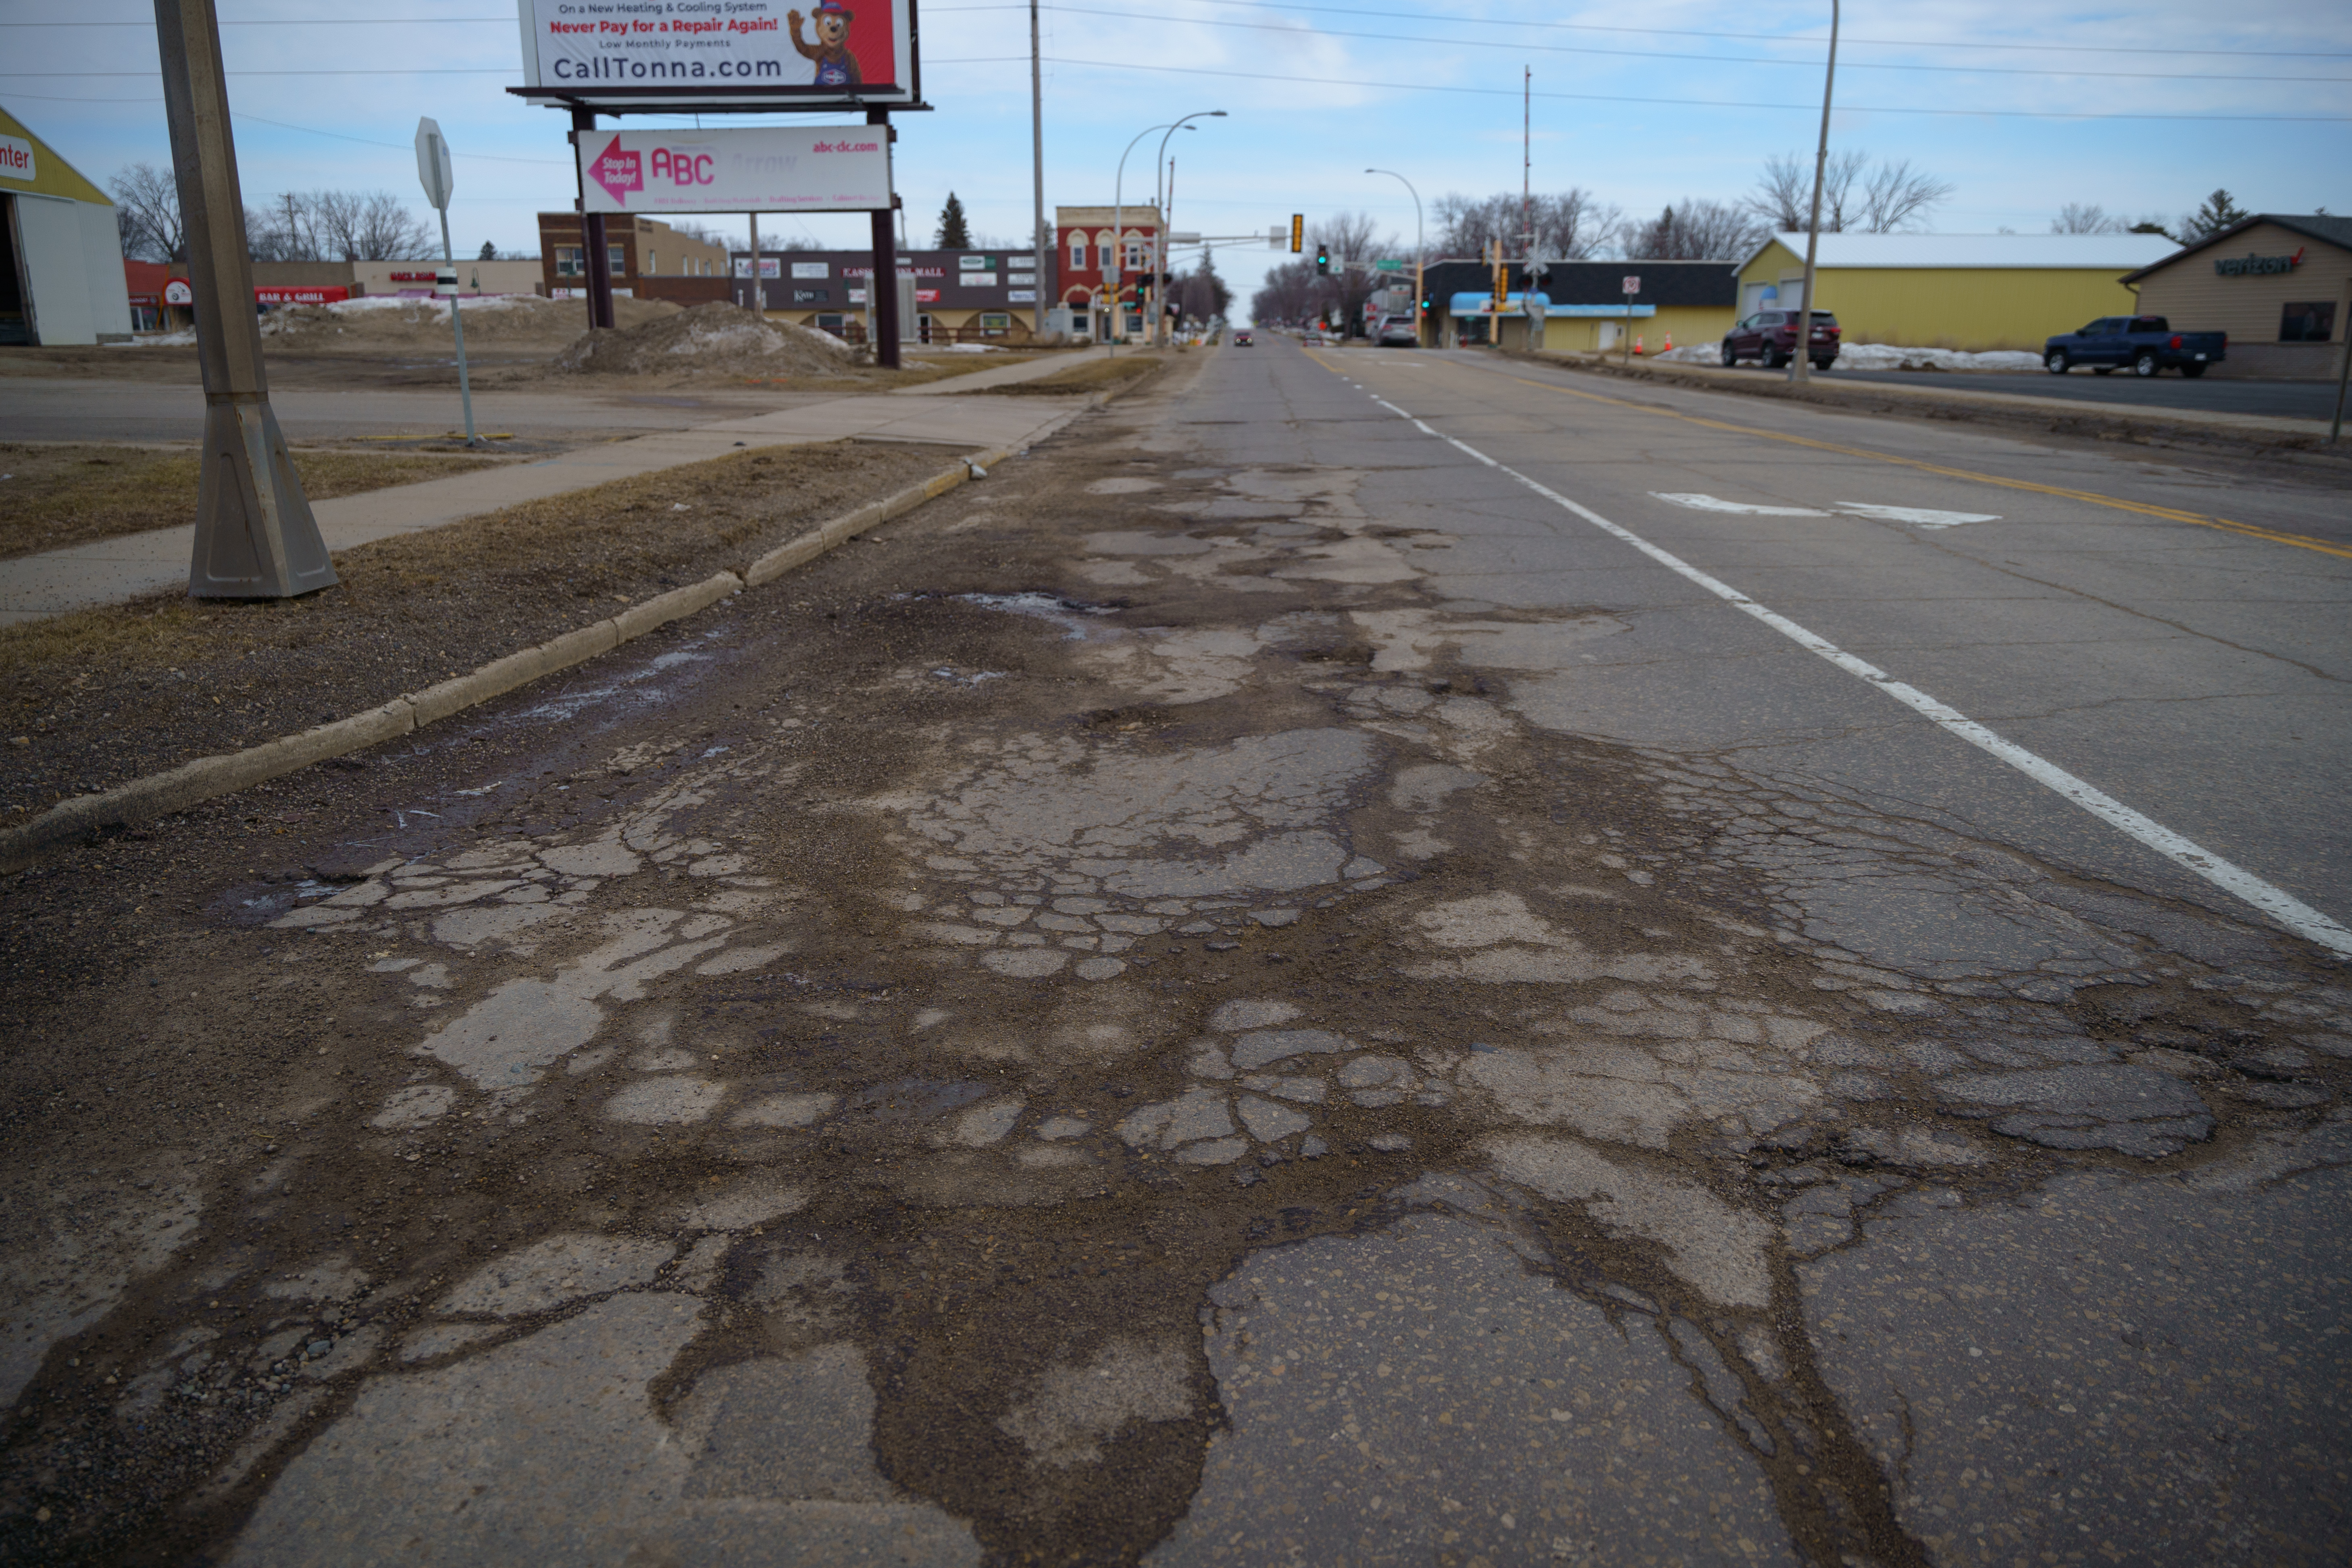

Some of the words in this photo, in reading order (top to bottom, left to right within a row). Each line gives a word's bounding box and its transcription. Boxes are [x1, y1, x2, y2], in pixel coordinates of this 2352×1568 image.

[560, 4, 575, 13] On
[589, 4, 614, 12] New
[618, 2, 662, 15] Heating
[666, 3, 674, 12] &
[678, 2, 721, 14] Cooling
[725, 2, 767, 13] System
[550, 21, 595, 33] Never
[600, 20, 628, 36] Pay
[633, 19, 655, 32] for
[659, 22, 668, 32] a
[673, 17, 723, 35] Repair
[728, 17, 778, 33] Again!
[627, 40, 671, 49] Monthly
[676, 40, 731, 49] Payments
[555, 56, 781, 78] CallTonna.com
[602, 157, 624, 170] Stop
[651, 147, 715, 186] ABC
[605, 171, 637, 186] Today!
[2215, 252, 2292, 276] verizon
[259, 293, 281, 301] BAR
[283, 293, 292, 301] &
[295, 293, 325, 302] GRILL
